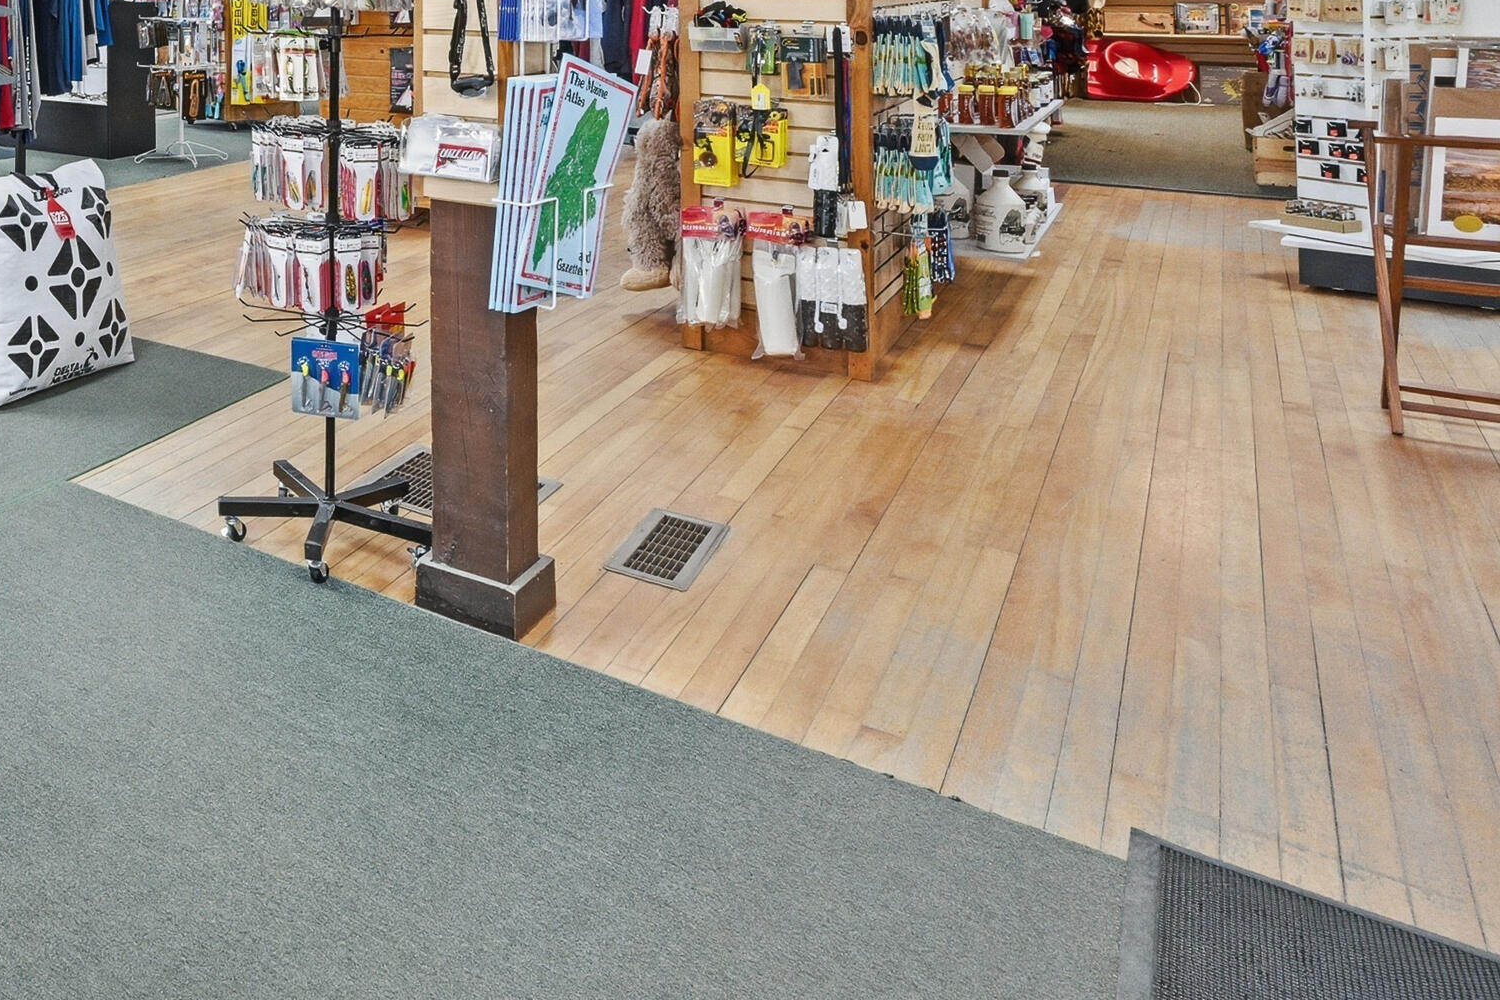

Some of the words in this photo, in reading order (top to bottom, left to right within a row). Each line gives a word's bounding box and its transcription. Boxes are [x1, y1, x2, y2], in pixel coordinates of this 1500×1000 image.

[569, 70, 586, 89] The
[586, 76, 609, 100] Maine
[564, 88, 586, 108] Atlas
[579, 251, 592, 264] ad
[556, 258, 589, 277] Gazetter
